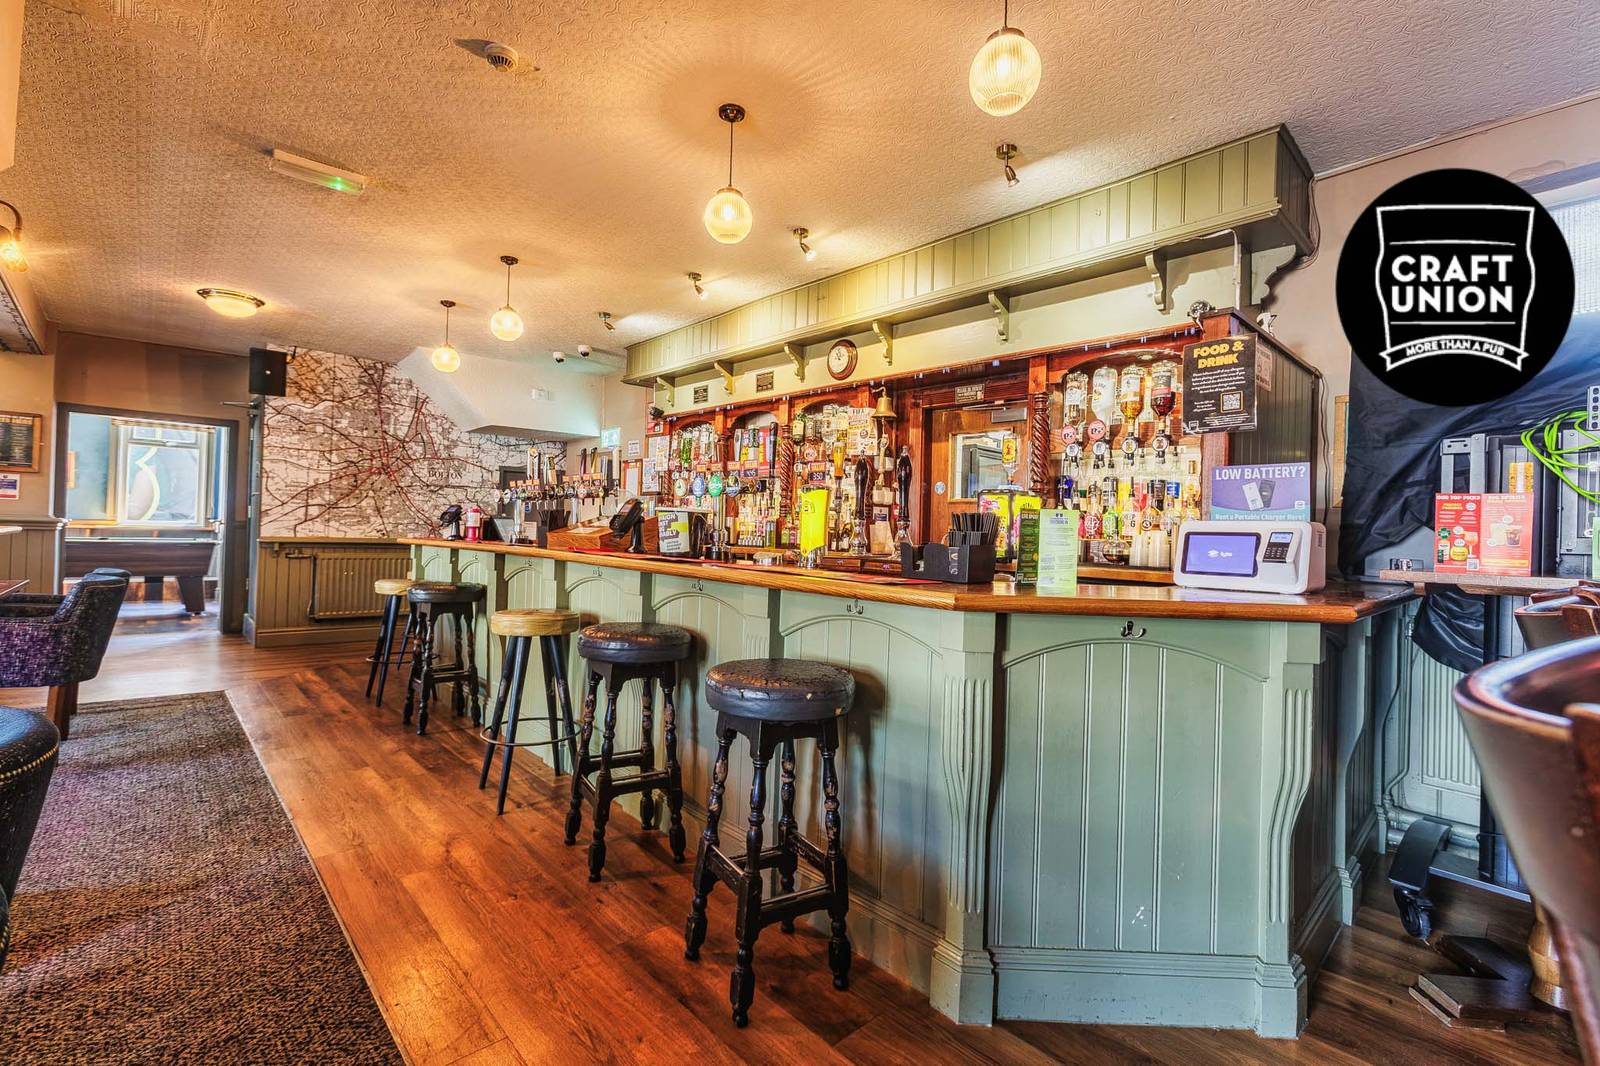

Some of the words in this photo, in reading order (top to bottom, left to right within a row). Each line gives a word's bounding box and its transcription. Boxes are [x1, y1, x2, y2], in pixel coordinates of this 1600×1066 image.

[1193, 343, 1230, 358] FOOD
[1232, 341, 1245, 351] &
[1198, 353, 1239, 369] DRINK
[1215, 468, 1241, 480] LOW
[1244, 466, 1306, 480] BATTERY?
